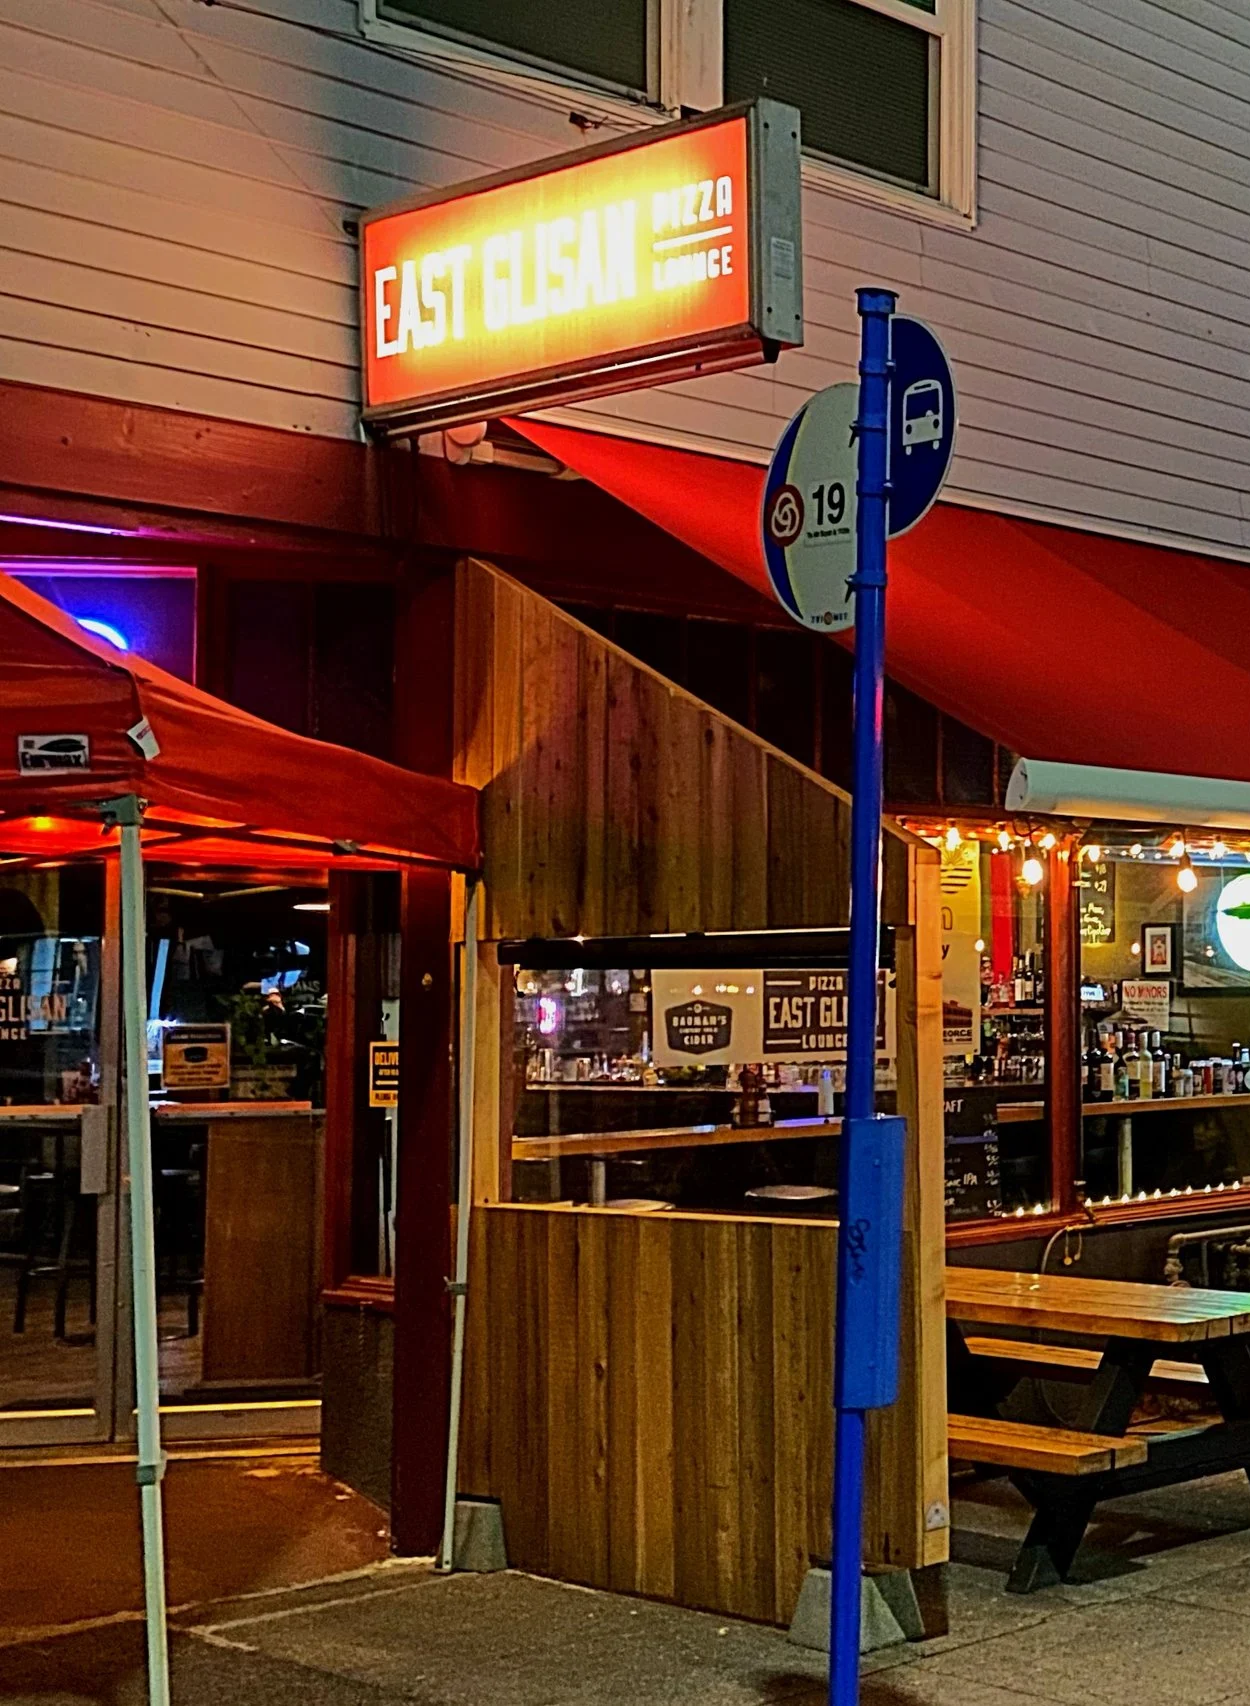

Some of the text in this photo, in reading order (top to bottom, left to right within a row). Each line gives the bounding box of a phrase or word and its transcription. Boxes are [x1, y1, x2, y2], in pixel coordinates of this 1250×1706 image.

[652, 176, 732, 234] PIZZA
[375, 199, 637, 358] EAST GLISAN
[652, 245, 733, 292] LOUNGE
[812, 482, 845, 525] 19
[809, 976, 843, 990] PIZZA
[1124, 986, 1167, 998] NO MINORS
[769, 997, 815, 1028] EAST
[684, 1034, 714, 1045] CIDER
